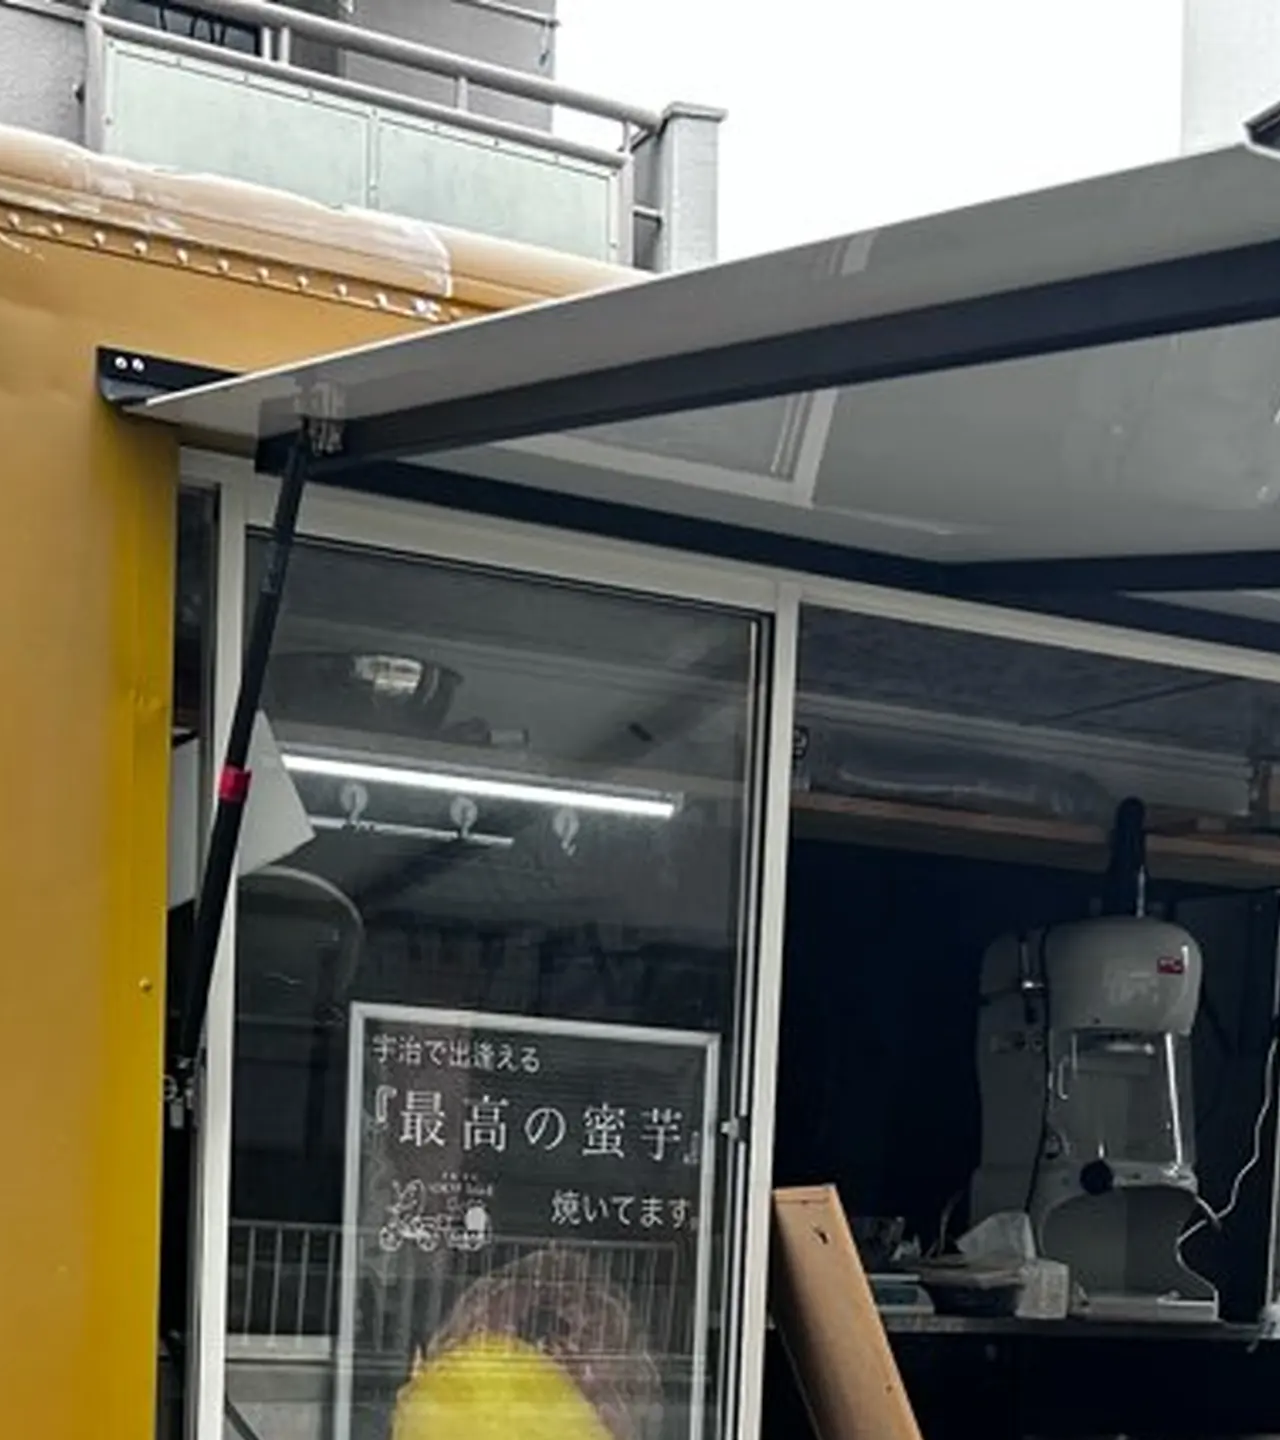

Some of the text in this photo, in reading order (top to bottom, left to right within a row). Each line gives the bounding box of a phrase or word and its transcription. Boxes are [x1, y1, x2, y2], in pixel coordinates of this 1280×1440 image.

[372, 1033, 541, 1073] 宇治で出逢える
